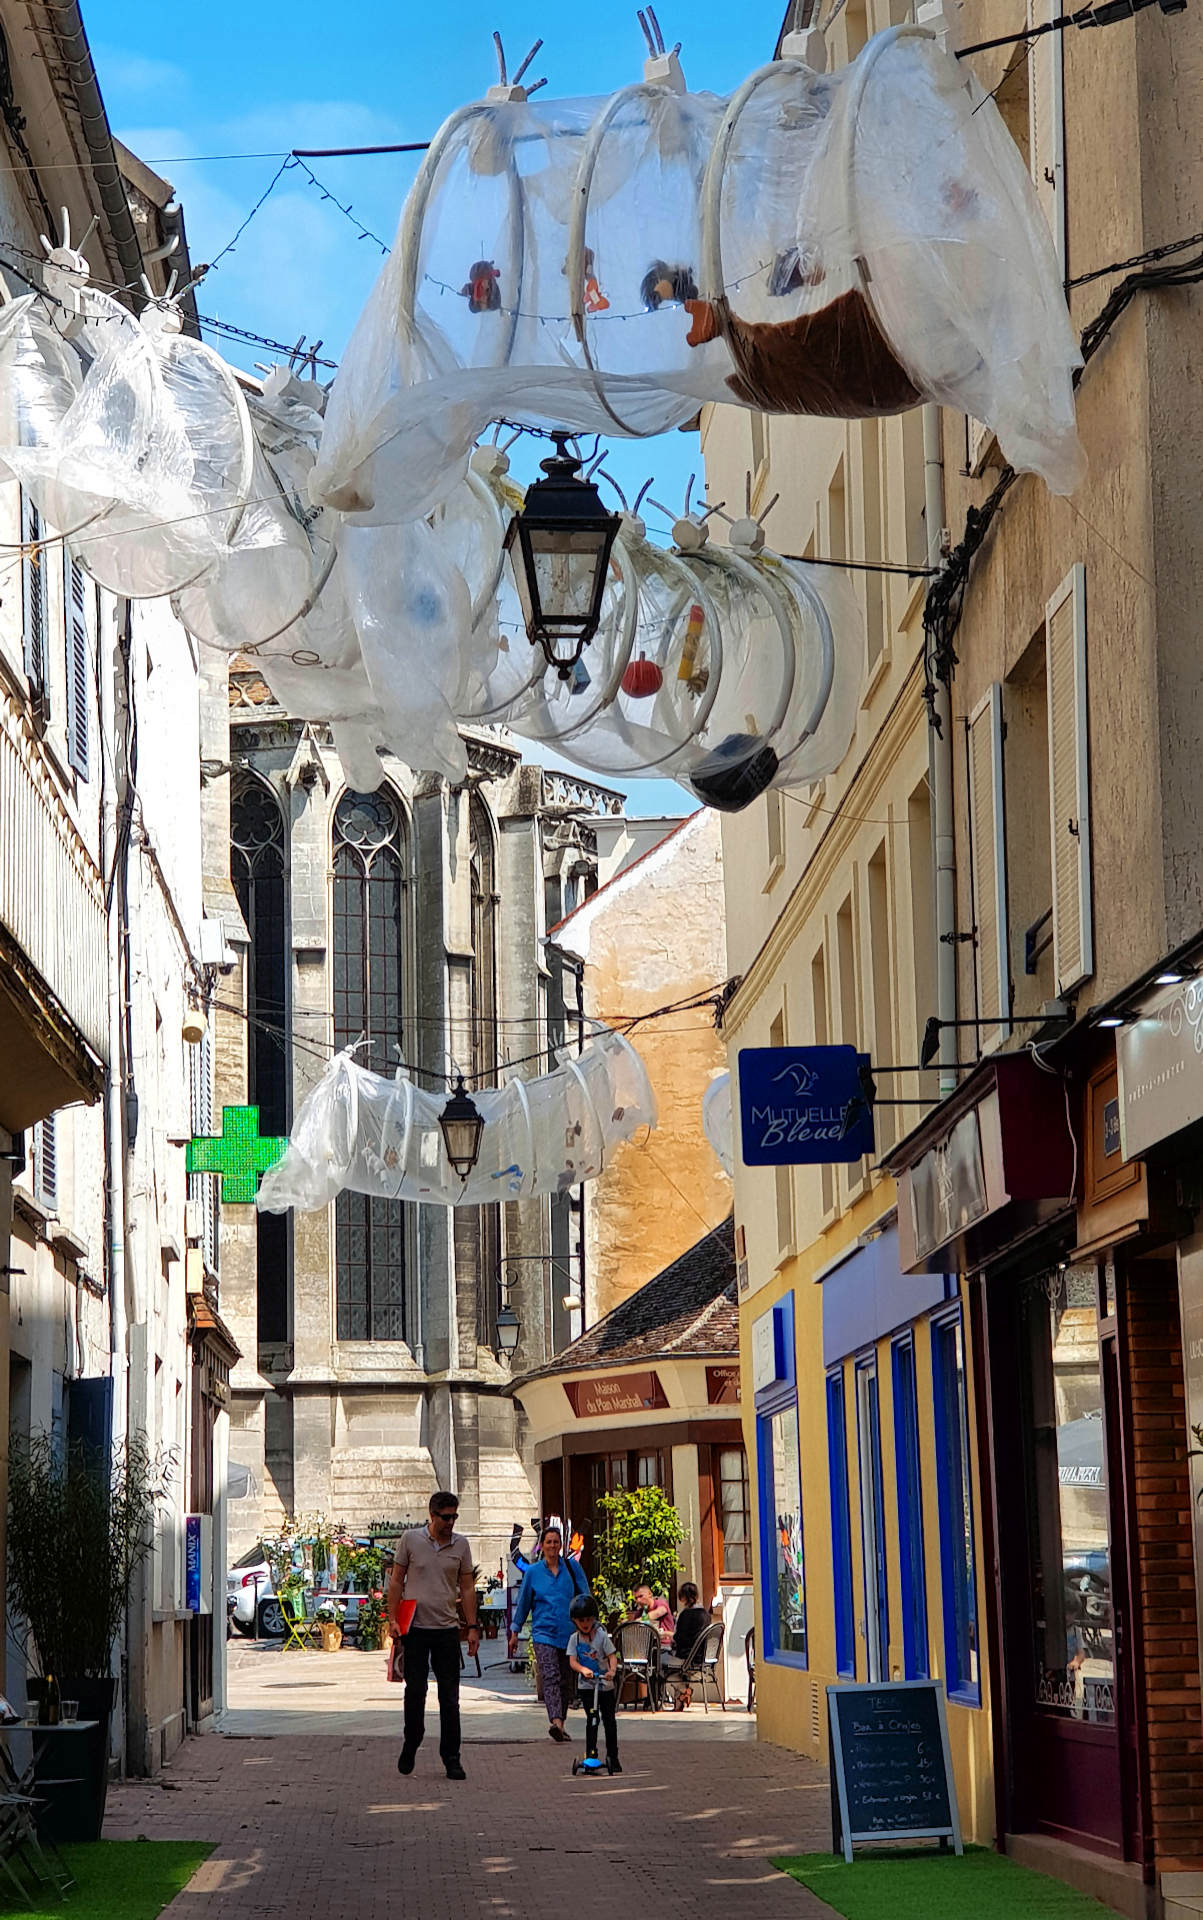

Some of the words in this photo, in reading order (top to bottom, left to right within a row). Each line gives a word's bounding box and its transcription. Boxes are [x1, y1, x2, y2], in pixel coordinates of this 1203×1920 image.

[751, 1105, 848, 1125] MUTUELLE
[760, 1117, 846, 1148] Bleue
[713, 1369, 735, 1378] Office
[593, 1382, 621, 1396] Maison
[586, 1399, 597, 1414] du
[597, 1397, 613, 1412] Plan
[612, 1393, 643, 1410] Marshall
[188, 1533, 197, 1572] MANIX
